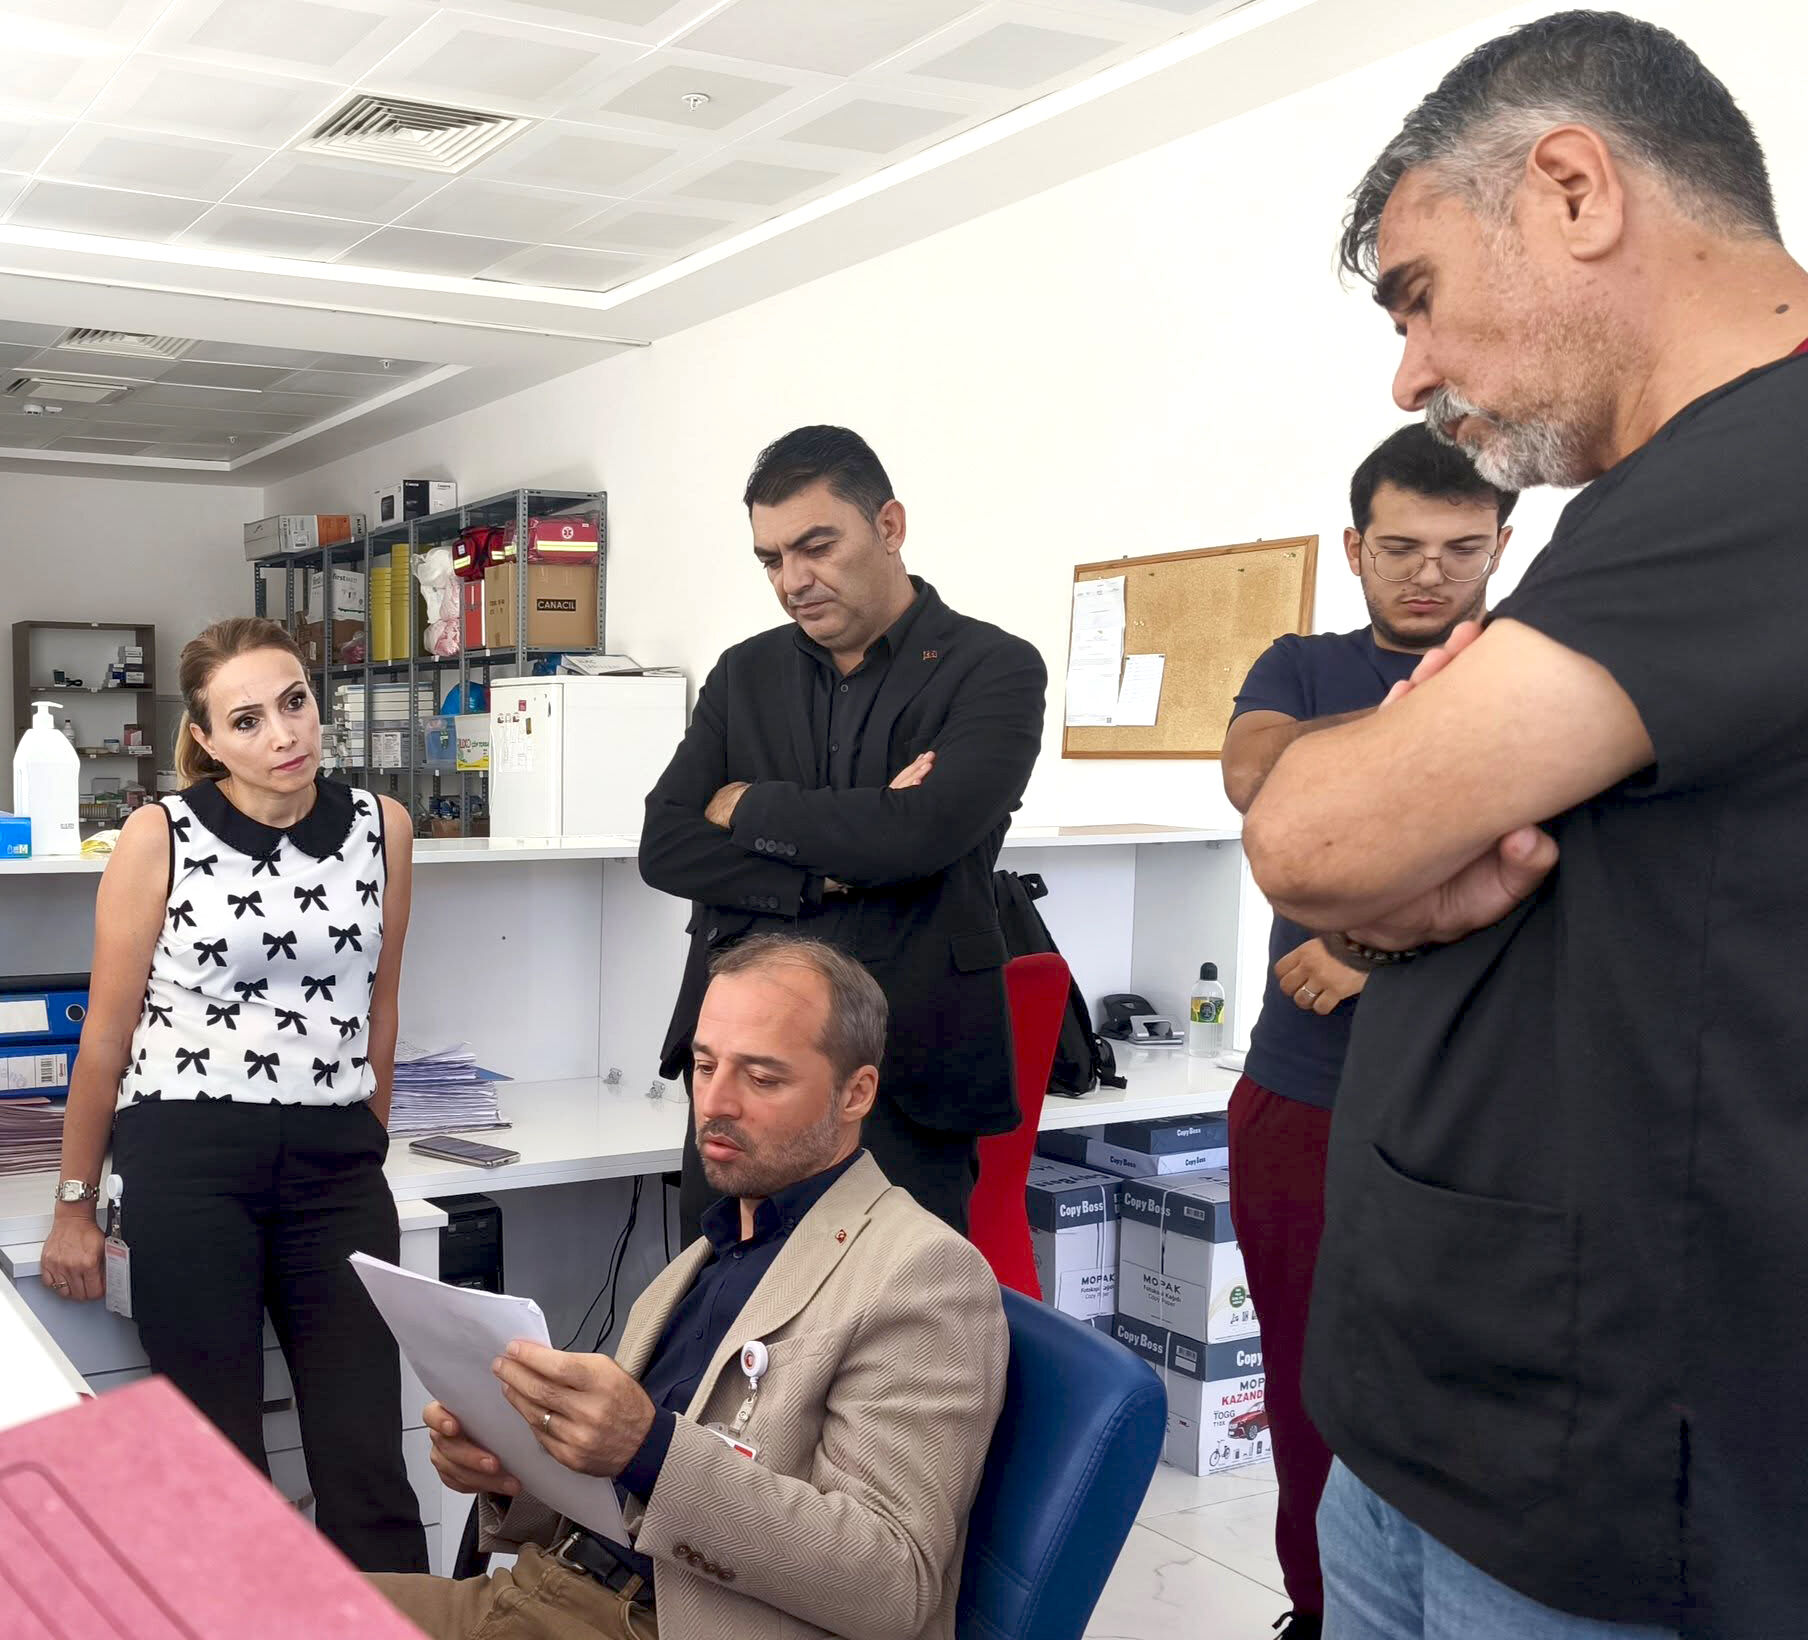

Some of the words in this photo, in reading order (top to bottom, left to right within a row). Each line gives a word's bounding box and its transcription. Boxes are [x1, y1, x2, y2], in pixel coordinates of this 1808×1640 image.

[537, 600, 575, 610] CANACIL
[1081, 1273, 1116, 1286] MOPAK
[1236, 1350, 1263, 1368] Copy
[1214, 1410, 1235, 1420] TOGG
